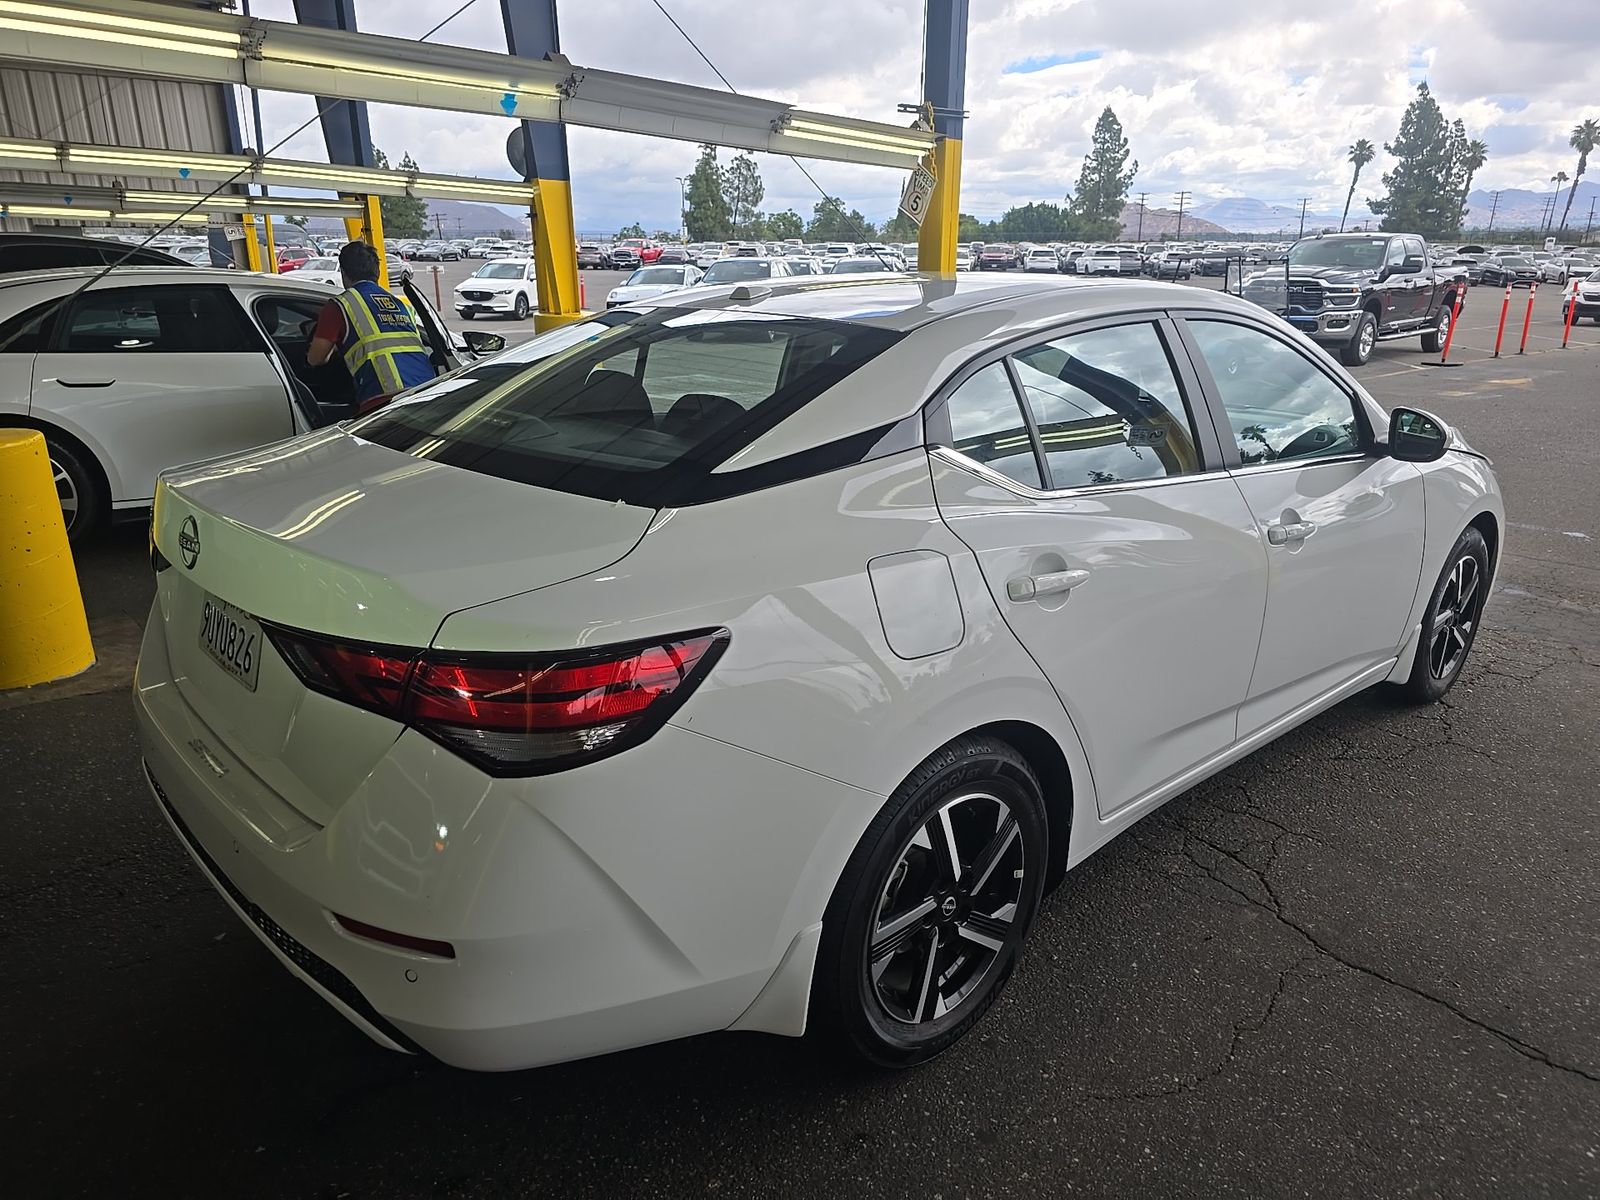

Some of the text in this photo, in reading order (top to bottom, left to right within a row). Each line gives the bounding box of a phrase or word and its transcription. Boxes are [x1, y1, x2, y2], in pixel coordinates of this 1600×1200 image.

[914, 167, 933, 188] SPEED
[910, 195, 922, 212] 5
[201, 600, 254, 673] 9UYU826
